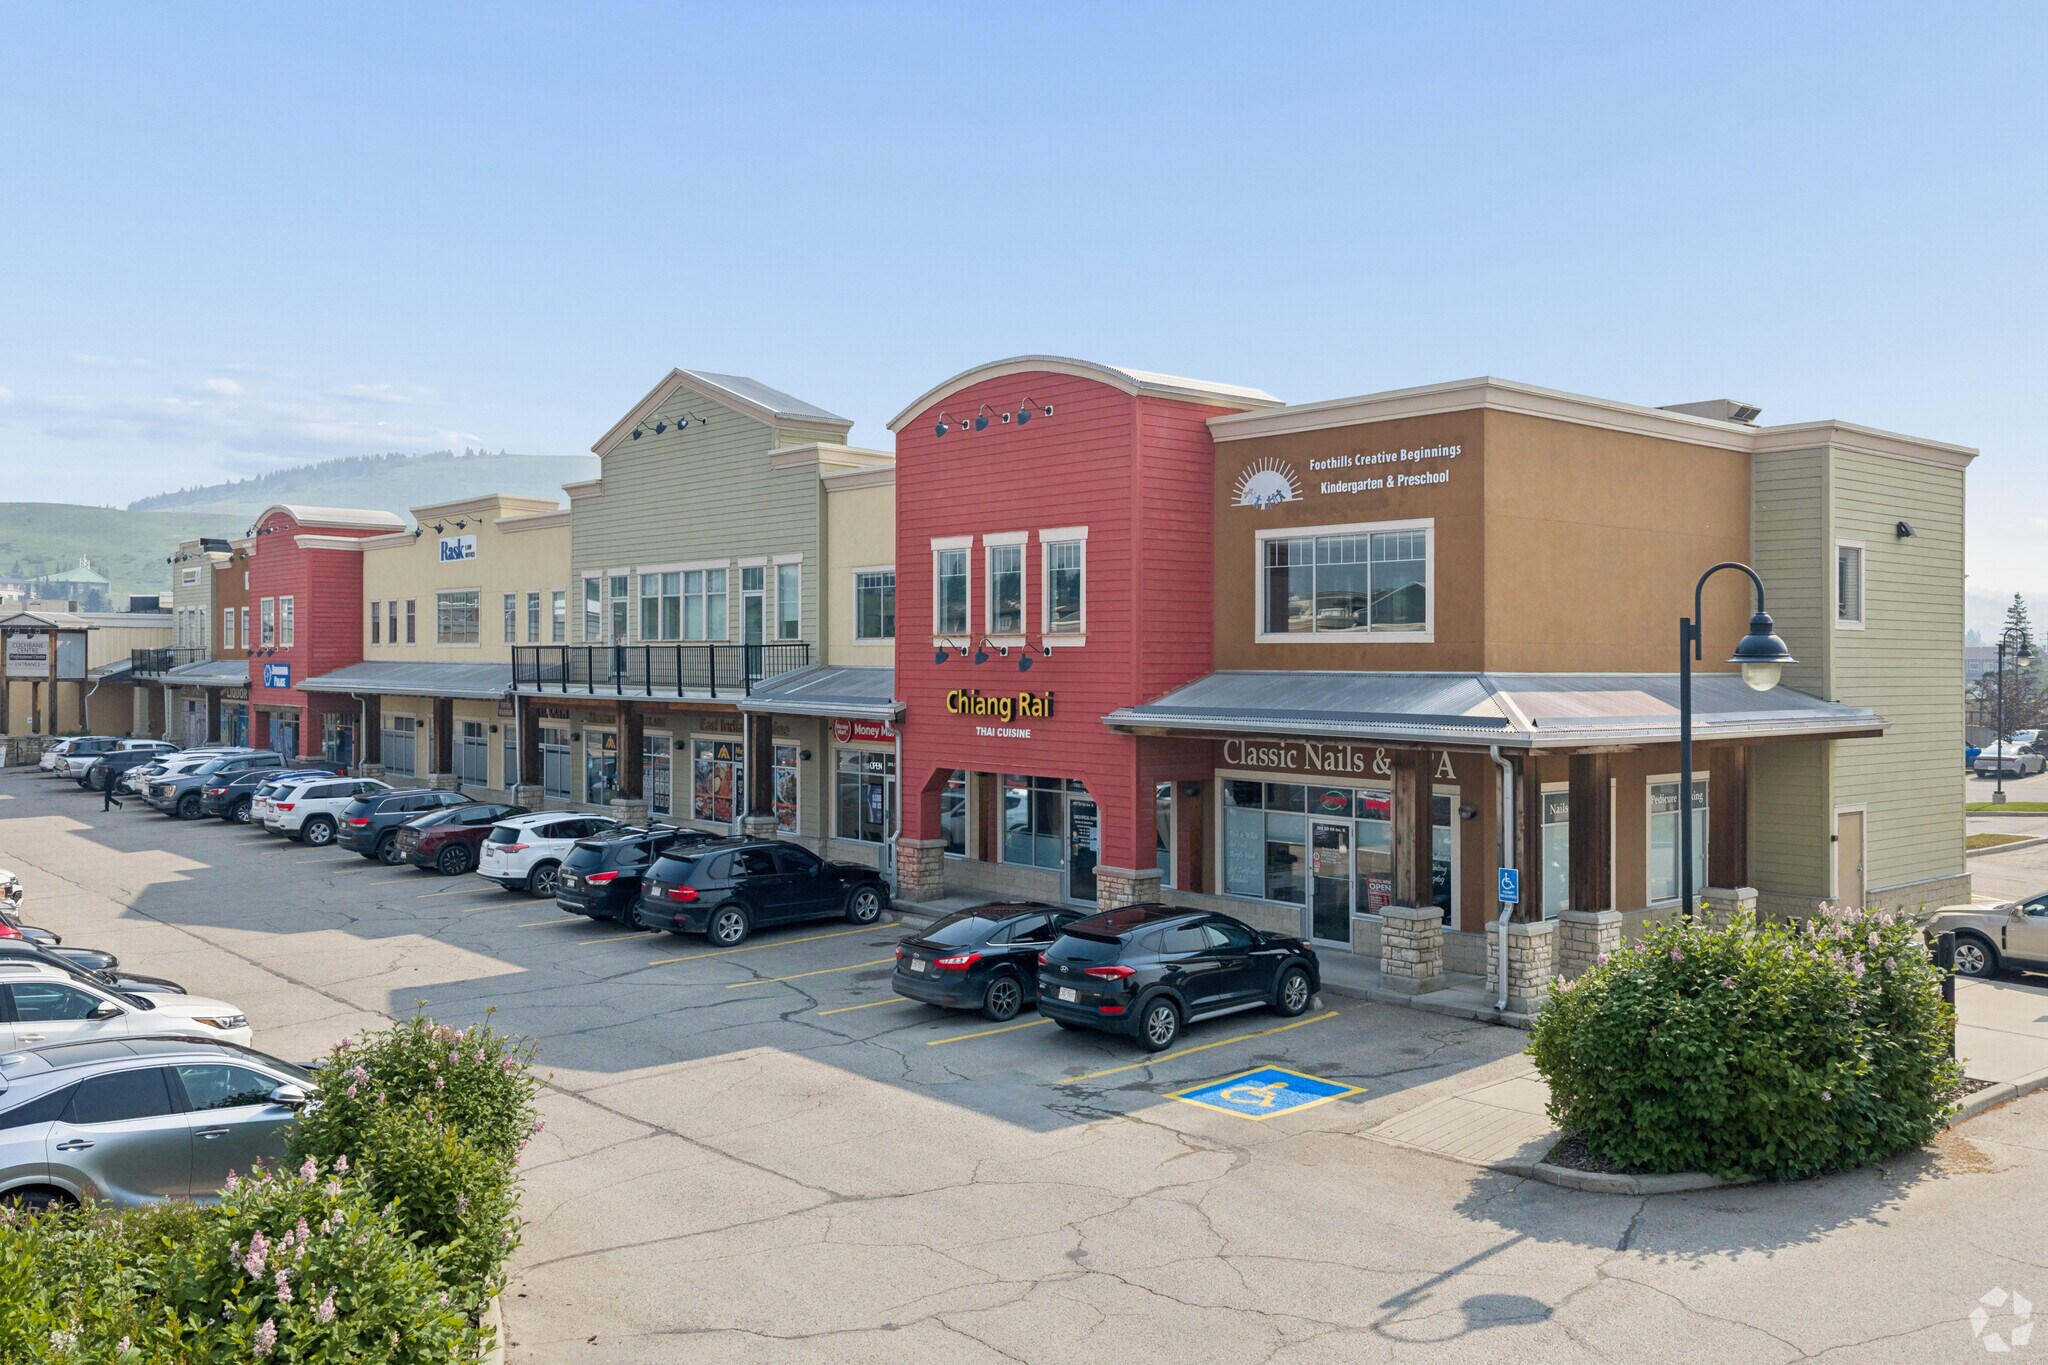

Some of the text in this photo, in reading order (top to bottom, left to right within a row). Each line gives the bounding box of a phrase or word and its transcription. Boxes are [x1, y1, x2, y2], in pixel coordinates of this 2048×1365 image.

[1309, 444, 1462, 471] Foothills Creative Beginnings
[1320, 470, 1449, 494] Kindergarten & Preschool
[440, 538, 464, 561] Rask
[226, 687, 248, 699] LIQUOR
[946, 689, 1054, 722] Chiang Rai
[854, 723, 880, 738] Money
[976, 726, 1031, 738] THAI CUISINE
[1223, 739, 1297, 769] Classic
[1303, 743, 1364, 772] Nails
[1372, 747, 1391, 774] &
[870, 762, 882, 770] OPEN
[1651, 794, 1677, 804] Pedicure
[1550, 802, 1569, 815] Nails
[1369, 882, 1391, 892] OPEN
